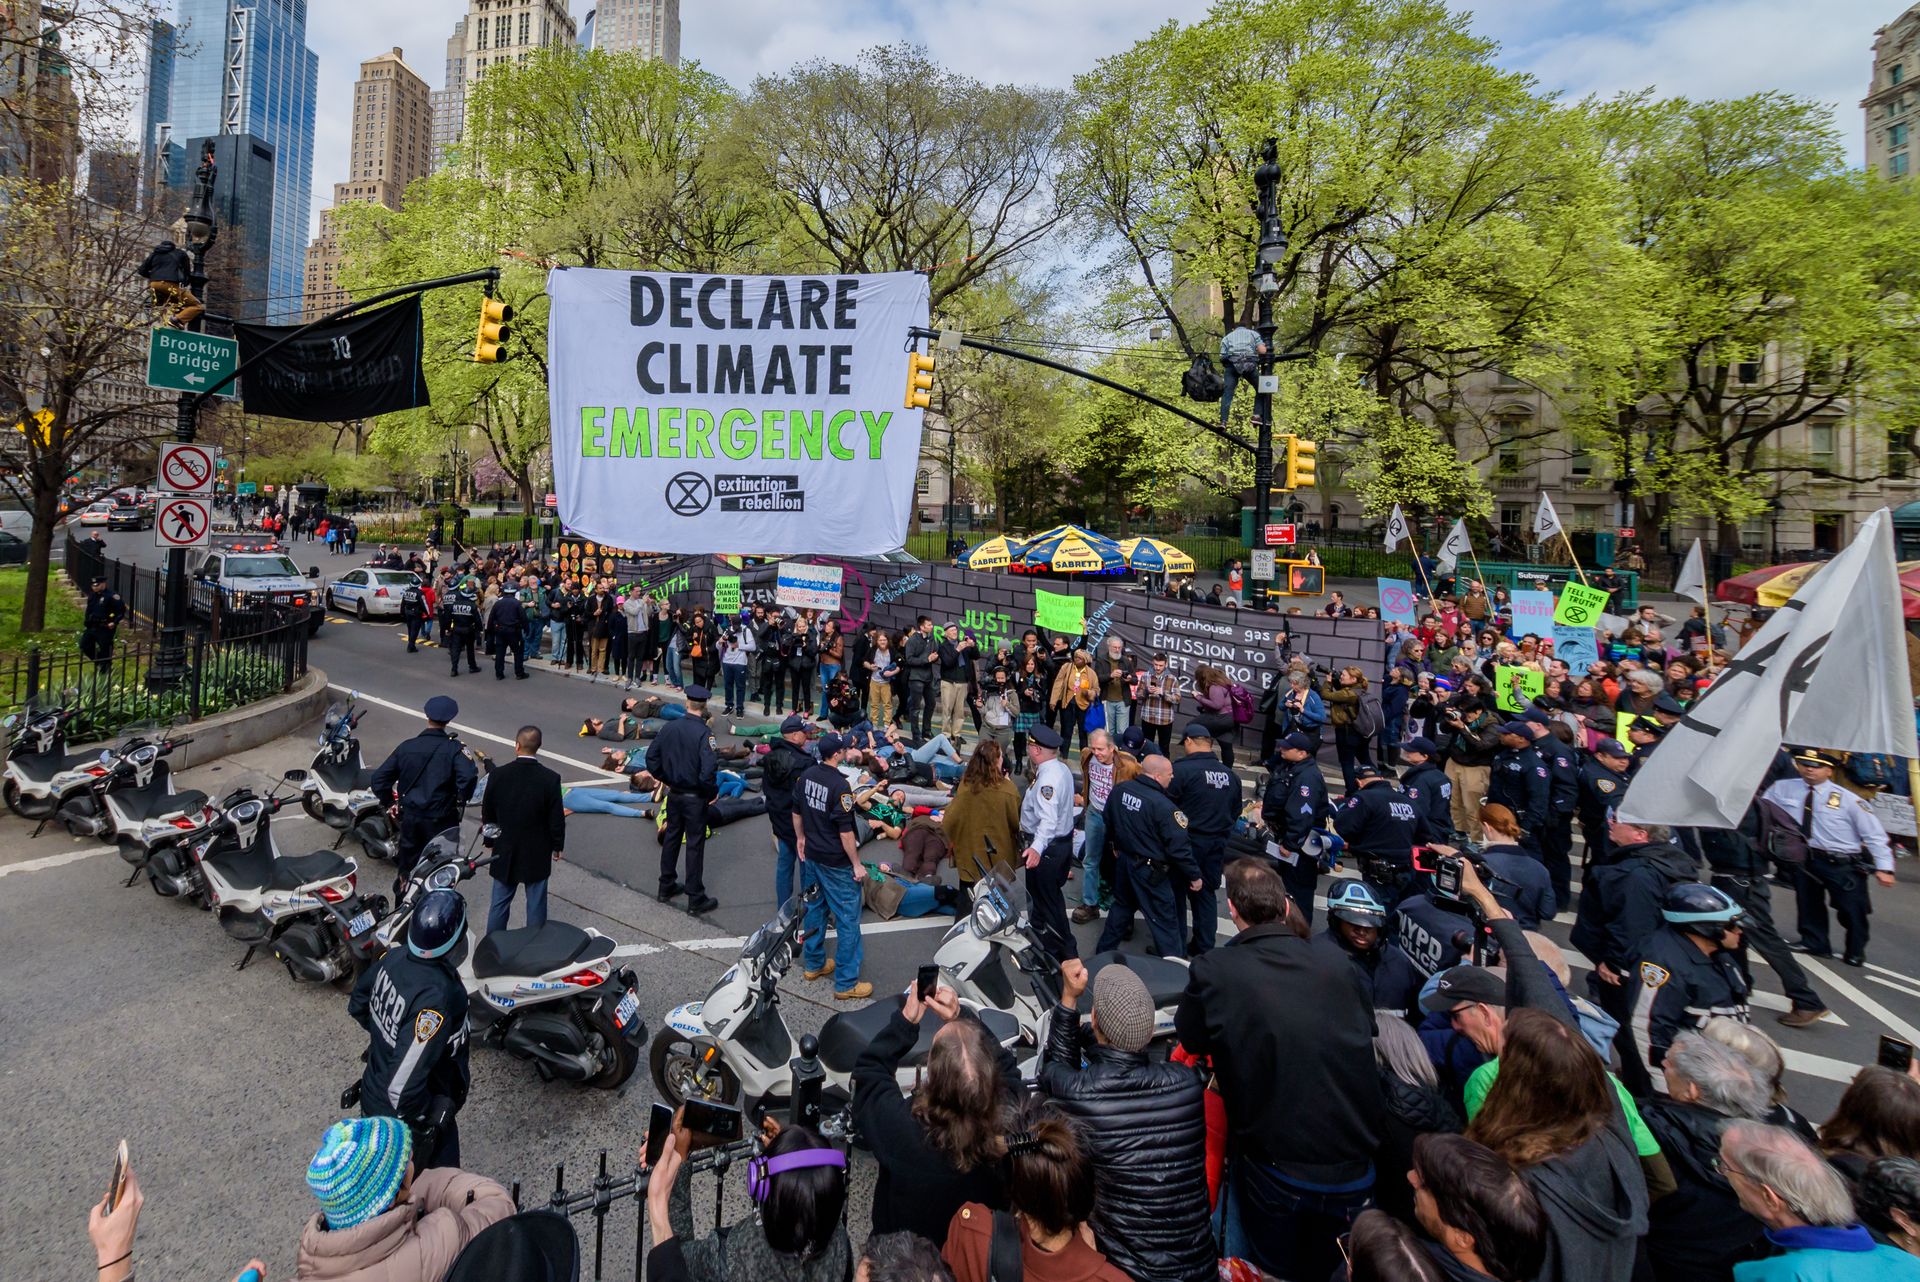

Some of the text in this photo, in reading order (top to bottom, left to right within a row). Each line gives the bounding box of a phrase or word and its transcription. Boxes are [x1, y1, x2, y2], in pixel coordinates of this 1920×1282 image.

[630, 275, 859, 330] DECLARE
[160, 335, 230, 358] Brooklyn
[168, 352, 220, 372] Bridge
[636, 341, 853, 395] CLIMATE
[580, 406, 894, 460] EMERGENCY
[718, 476, 787, 491] extinction
[739, 491, 801, 509] rebellion
[972, 556, 1008, 567] SABRETT
[1055, 560, 1099, 569] SABRETT
[1518, 572, 1549, 581] Subway
[1568, 587, 1604, 603] TELL THE
[1569, 595, 1596, 608] TRUTH
[1512, 604, 1554, 616] TRUTH
[959, 609, 1011, 634] JUST
[1153, 615, 1270, 642] greenhouse gas
[1153, 633, 1266, 663] EMISSION TO
[1205, 770, 1229, 782] NYPD
[805, 779, 828, 803] NYPD
[1122, 791, 1142, 809] NYPD
[1389, 802, 1413, 815] NYPD
[1396, 909, 1443, 961] NYPD
[371, 966, 405, 1024] NYPD
[490, 993, 515, 1008] NYPD
[672, 1022, 702, 1034] POLICE
